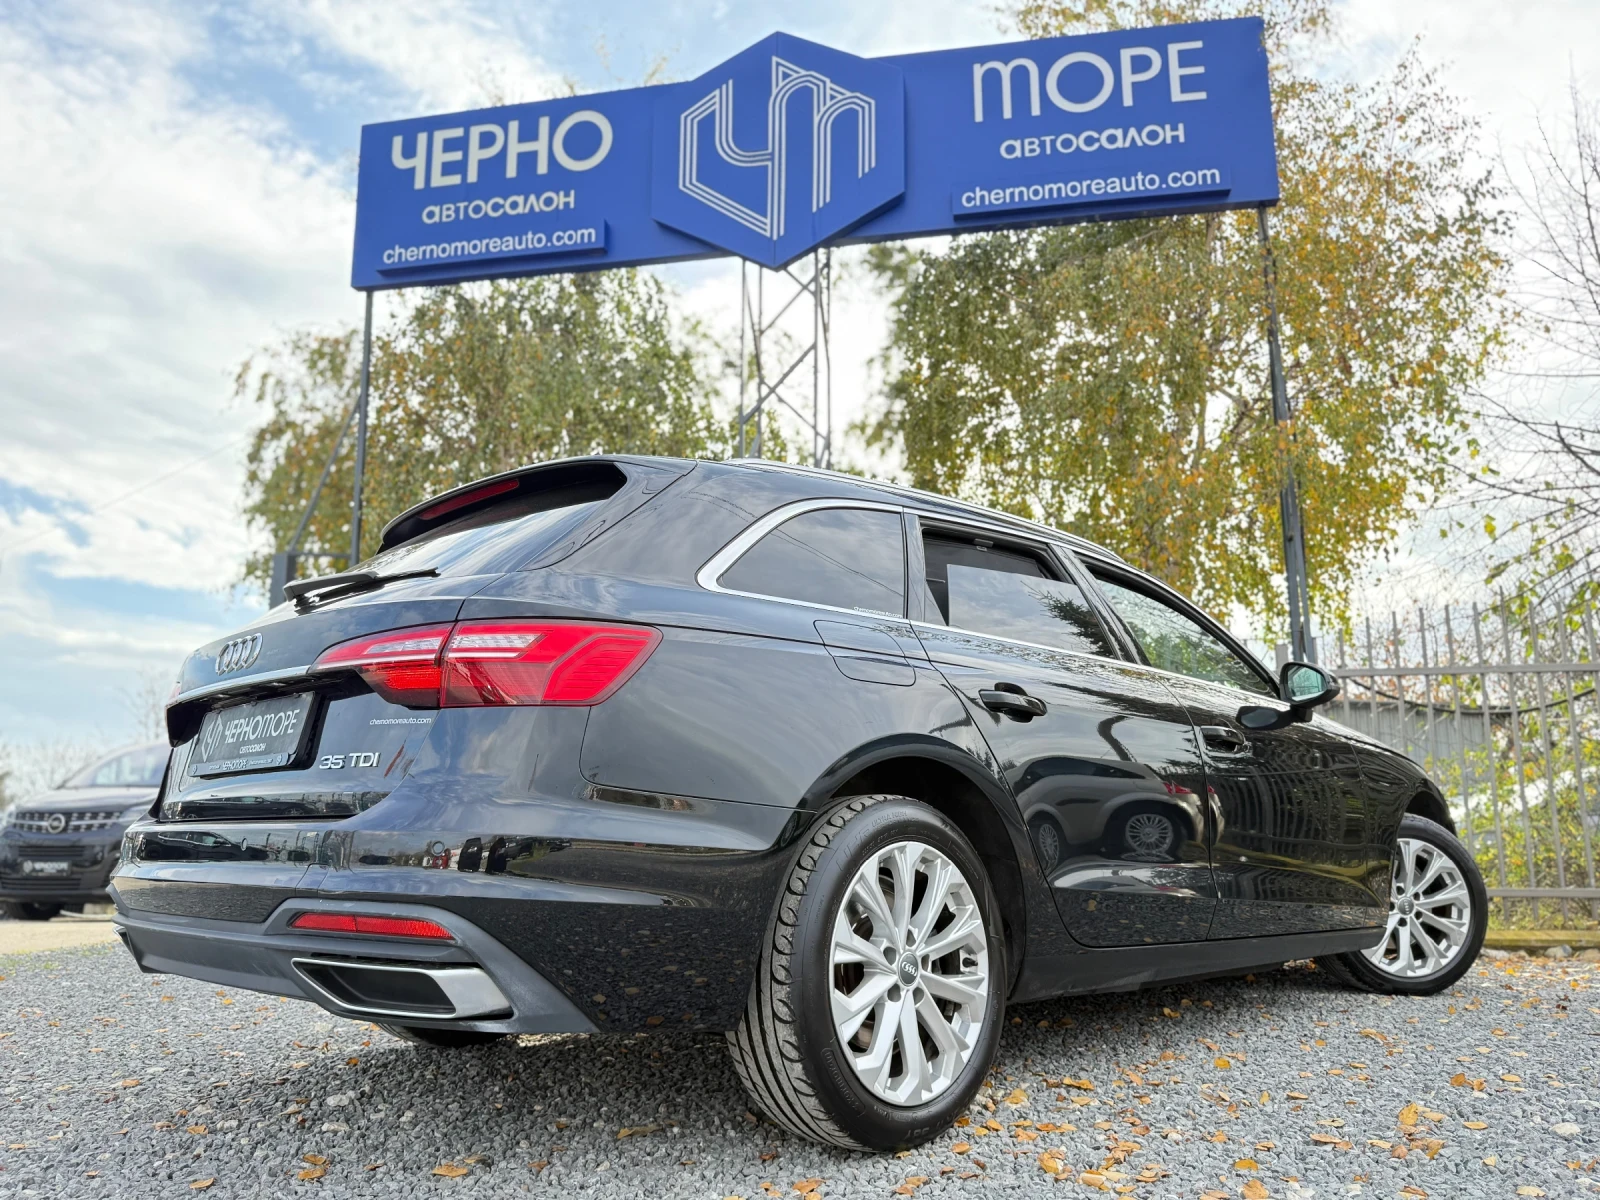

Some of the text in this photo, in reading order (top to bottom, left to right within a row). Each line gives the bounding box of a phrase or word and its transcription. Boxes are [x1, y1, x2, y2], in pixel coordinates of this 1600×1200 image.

[972, 40, 1208, 123] МОРЕ
[391, 109, 614, 191] ЧЕРНО
[961, 167, 1221, 208] chernomoreauto.com
[382, 225, 597, 265] chernomoreauto.com
[318, 752, 381, 770] 35 TDI
